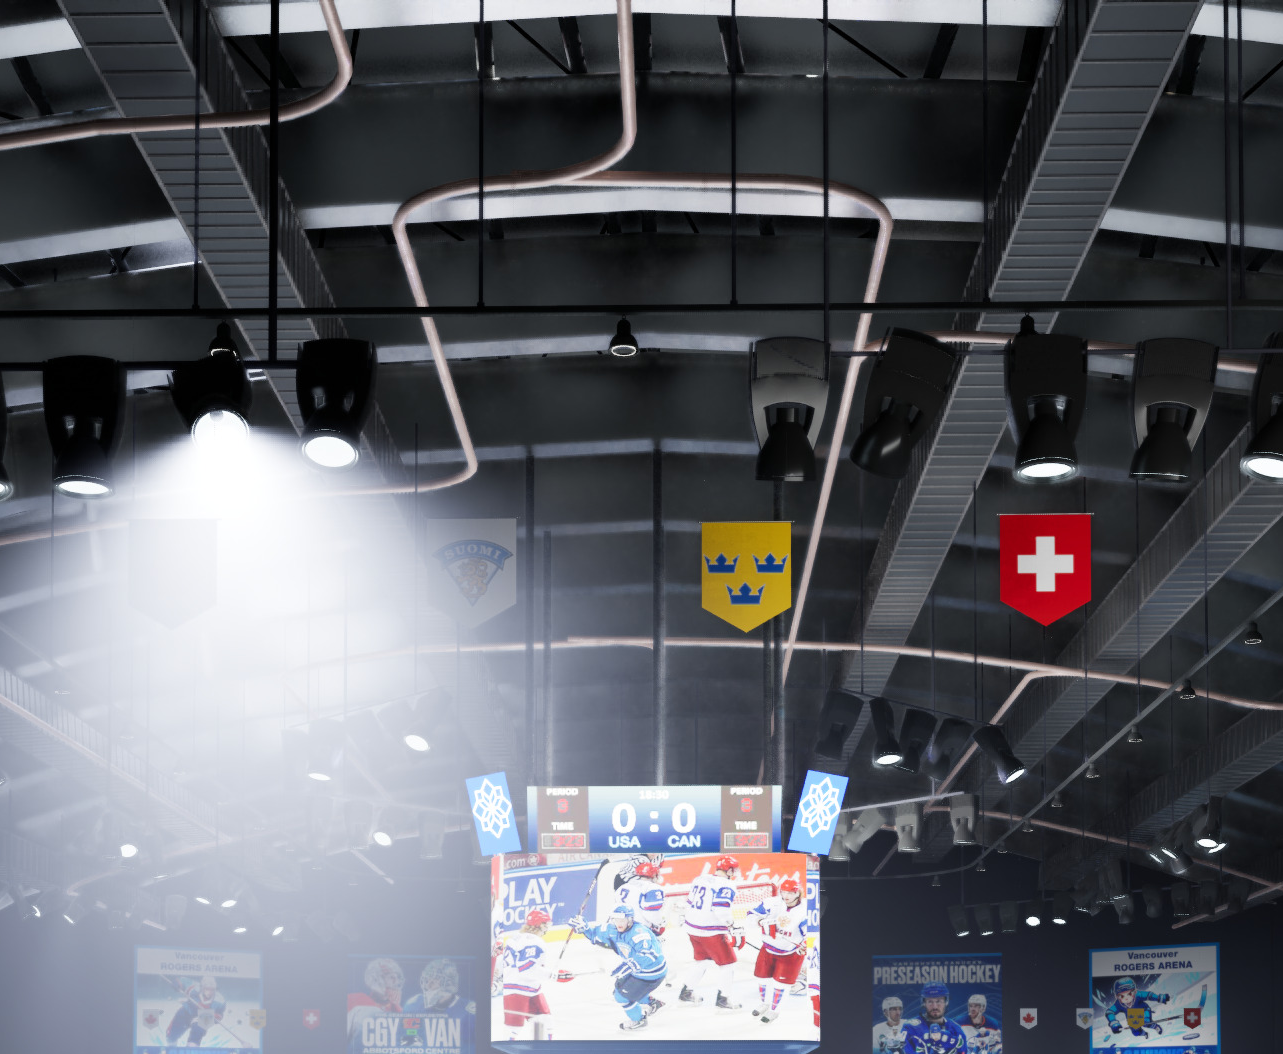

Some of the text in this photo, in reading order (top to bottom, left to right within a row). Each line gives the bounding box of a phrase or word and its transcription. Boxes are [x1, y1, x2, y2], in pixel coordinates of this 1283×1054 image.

[444, 544, 502, 560] SUOMI
[546, 787, 579, 797] PERIOD
[729, 786, 763, 796] PERIOD
[557, 798, 569, 813] 3
[741, 798, 753, 812] 3
[551, 821, 574, 831] TIME
[734, 820, 758, 830] TIME
[608, 835, 641, 848] USA
[667, 835, 701, 848] CAN
[175, 951, 225, 962] Vancouver
[1127, 951, 1178, 960] Vancouver
[160, 962, 238, 973] ROGERS ARENA
[1114, 960, 1193, 972] ROGERS ARENA
[873, 964, 1001, 985] PRESEASON HOCKEY
[362, 1017, 400, 1047] CGY
[424, 1018, 461, 1047] VAN
